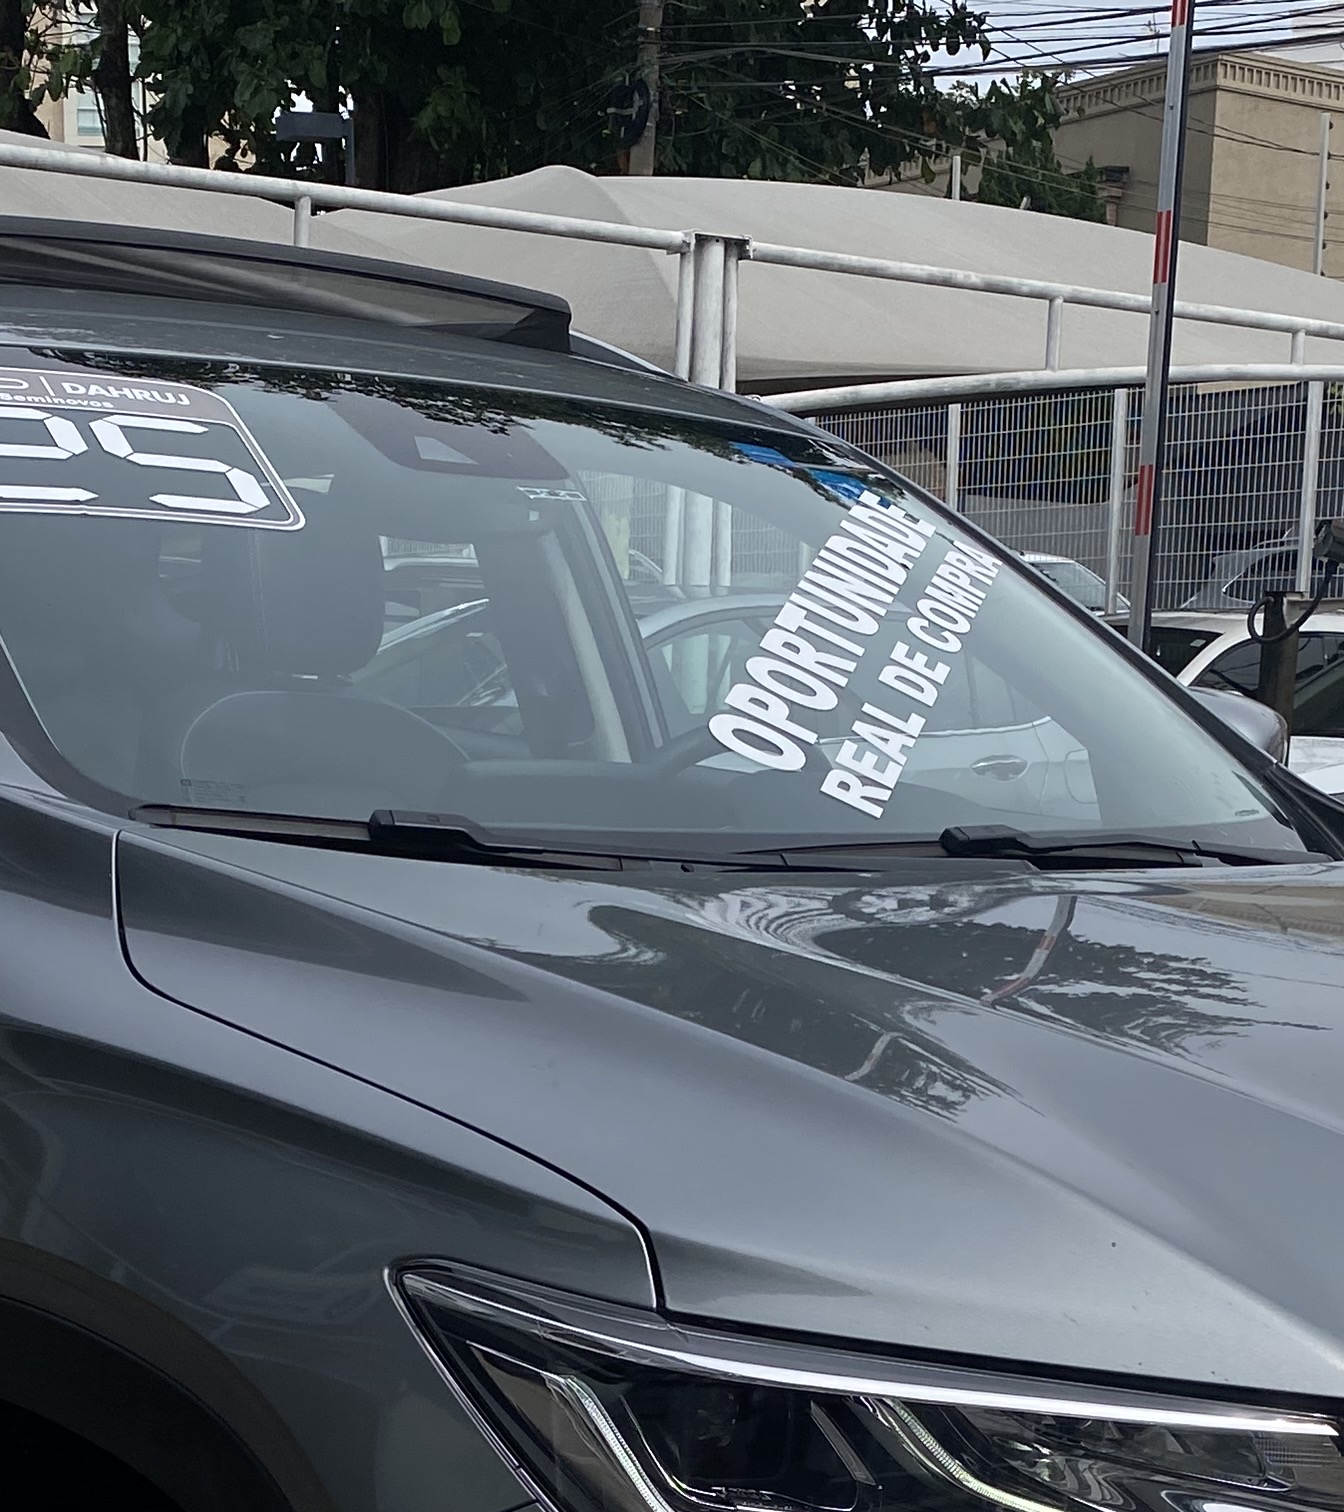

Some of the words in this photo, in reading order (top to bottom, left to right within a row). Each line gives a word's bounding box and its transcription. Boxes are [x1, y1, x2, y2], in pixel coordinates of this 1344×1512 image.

[60, 382, 191, 407] DAHRUJ
[708, 490, 937, 772] OPORTUNIDADE
[906, 540, 1004, 653] COMPRA
[878, 640, 951, 707] DE
[820, 703, 927, 819] REAL
